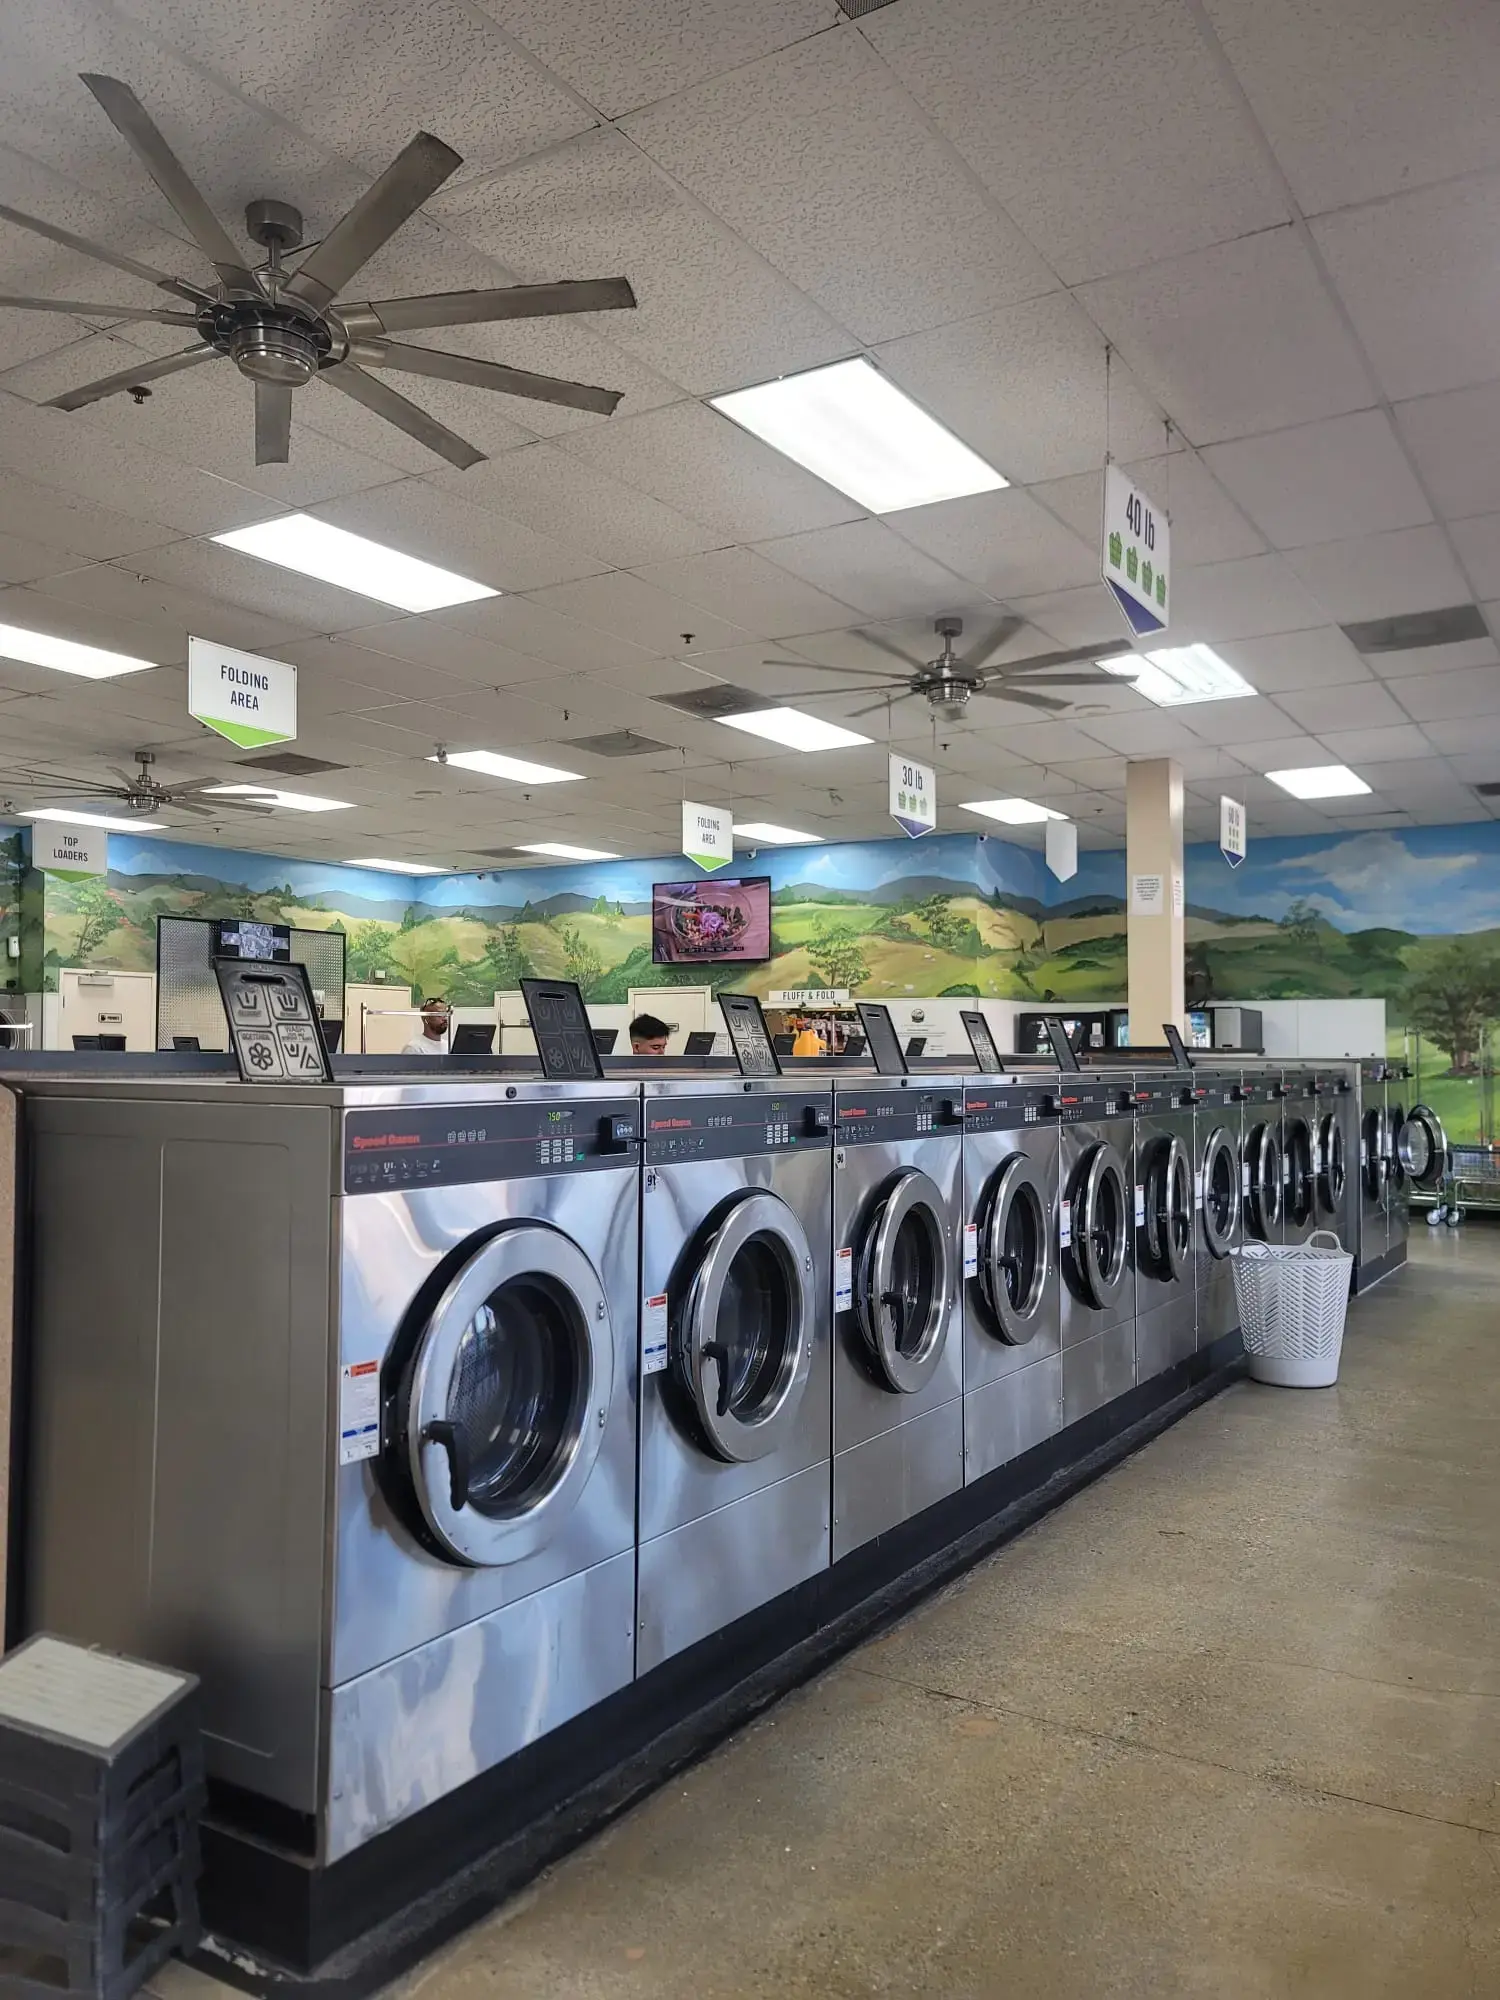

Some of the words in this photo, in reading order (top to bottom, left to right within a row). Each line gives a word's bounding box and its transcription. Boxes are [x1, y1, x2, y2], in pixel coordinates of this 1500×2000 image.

[1126, 492, 1142, 538] 40
[1144, 508, 1155, 551] lb
[221, 664, 269, 691] FOLDING
[230, 690, 259, 711] AREA
[902, 765, 913, 787] 30
[915, 769, 923, 791] lb
[697, 816, 720, 831] FOLDING
[63, 836, 79, 847] TOP
[701, 833, 716, 845] AREA
[53, 848, 89, 862] LOADERS
[782, 991, 805, 1000] FLUFF
[808, 991, 813, 1000] &
[816, 990, 835, 1000] FOLD
[647, 1174, 656, 1187] 91
